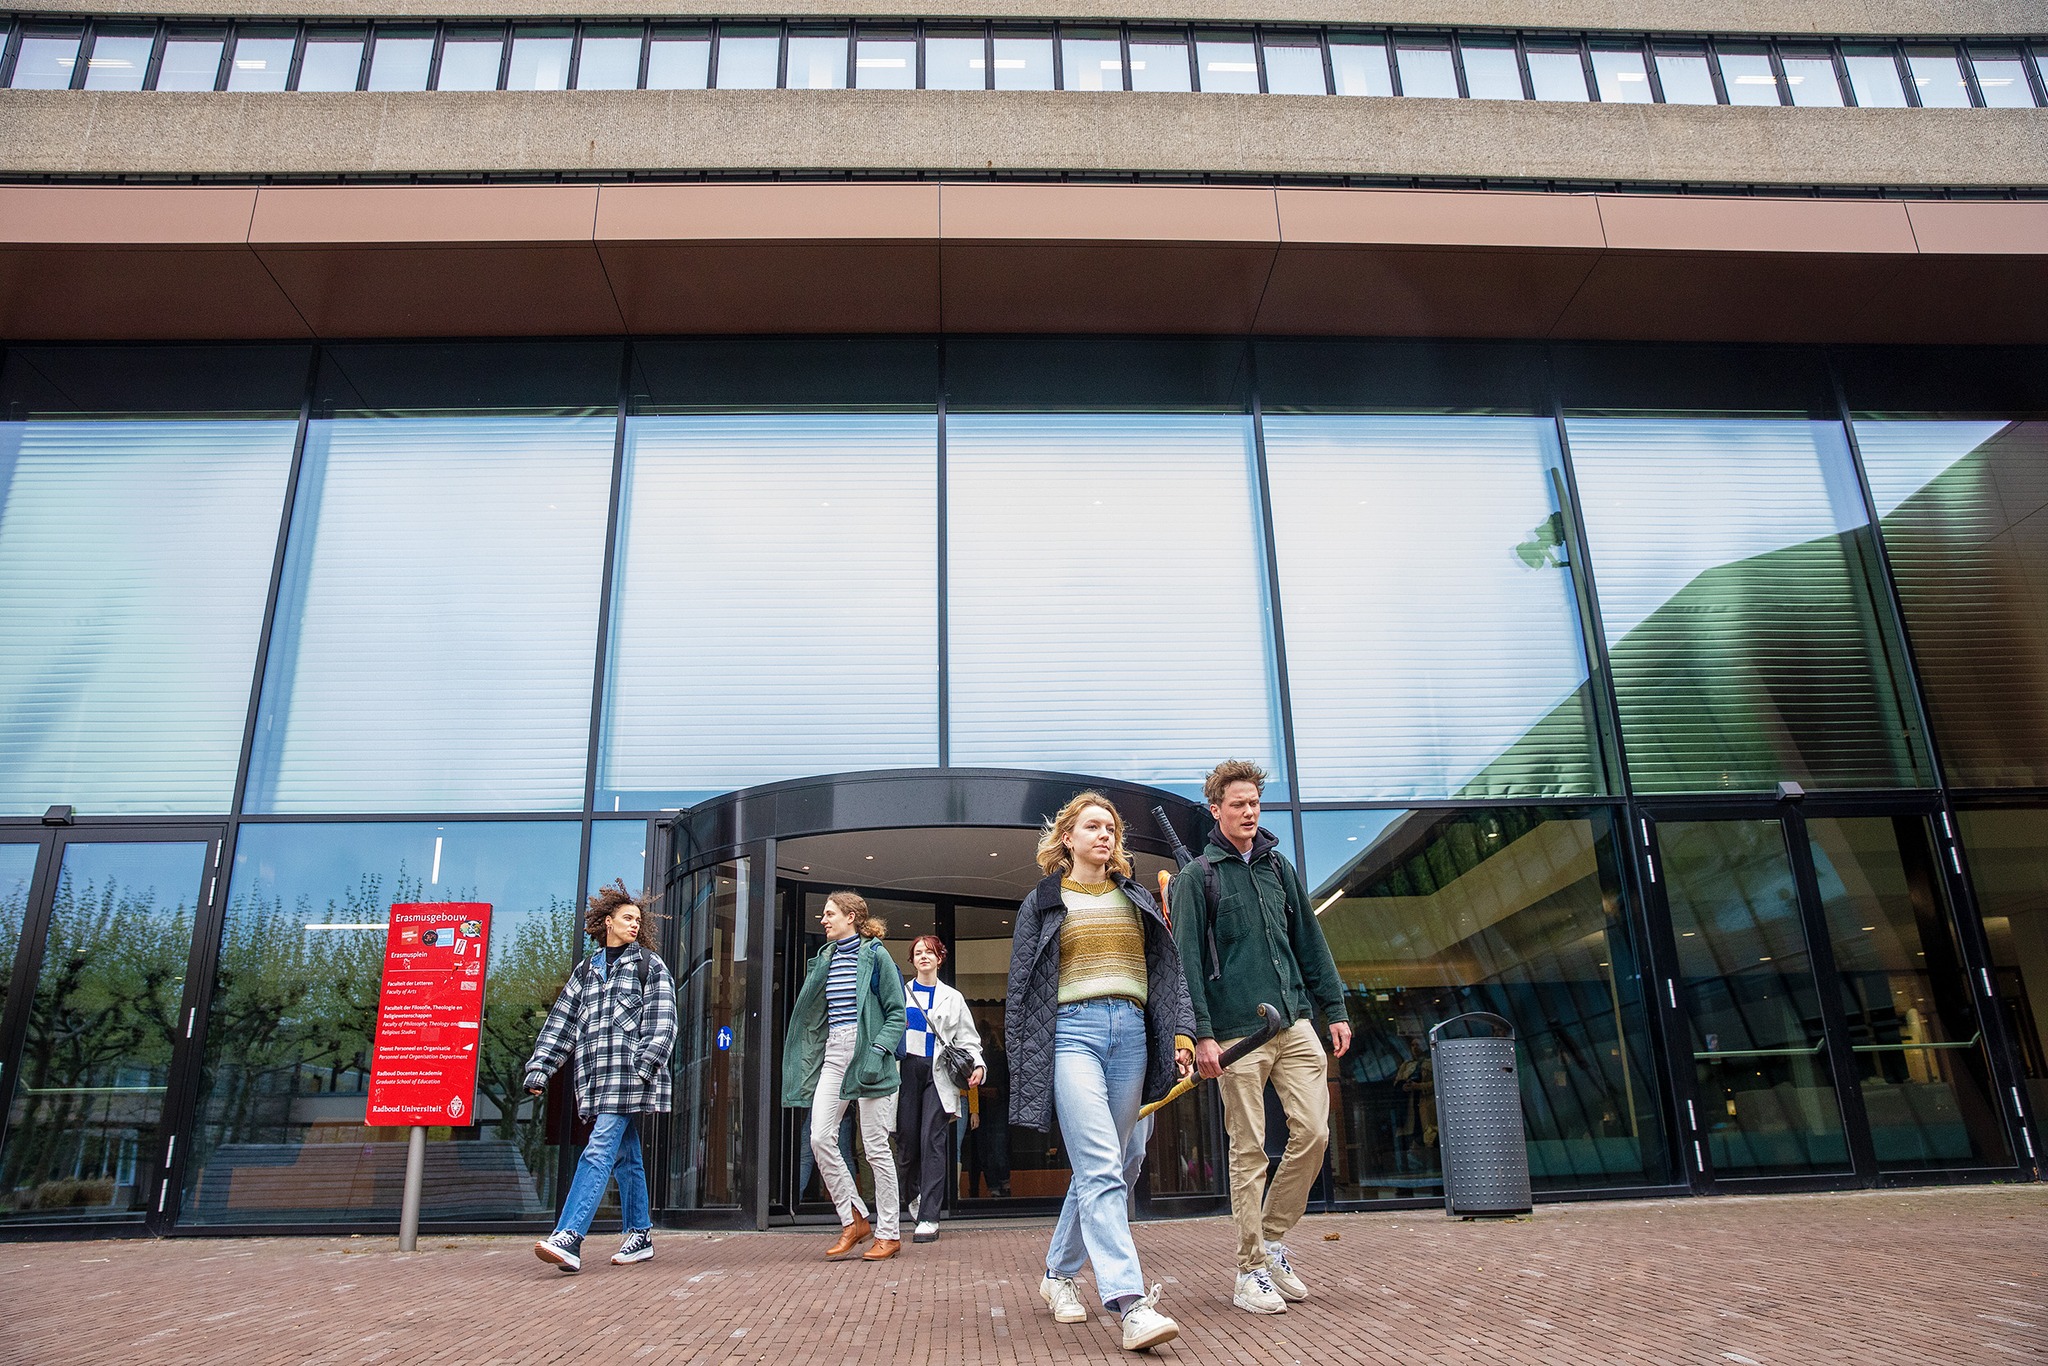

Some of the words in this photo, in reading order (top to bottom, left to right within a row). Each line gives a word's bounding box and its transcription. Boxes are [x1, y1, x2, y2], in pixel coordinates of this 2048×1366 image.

[396, 912, 468, 924] Erasmusgebouw
[391, 952, 428, 960] Erasmusplein
[473, 943, 480, 958] 1
